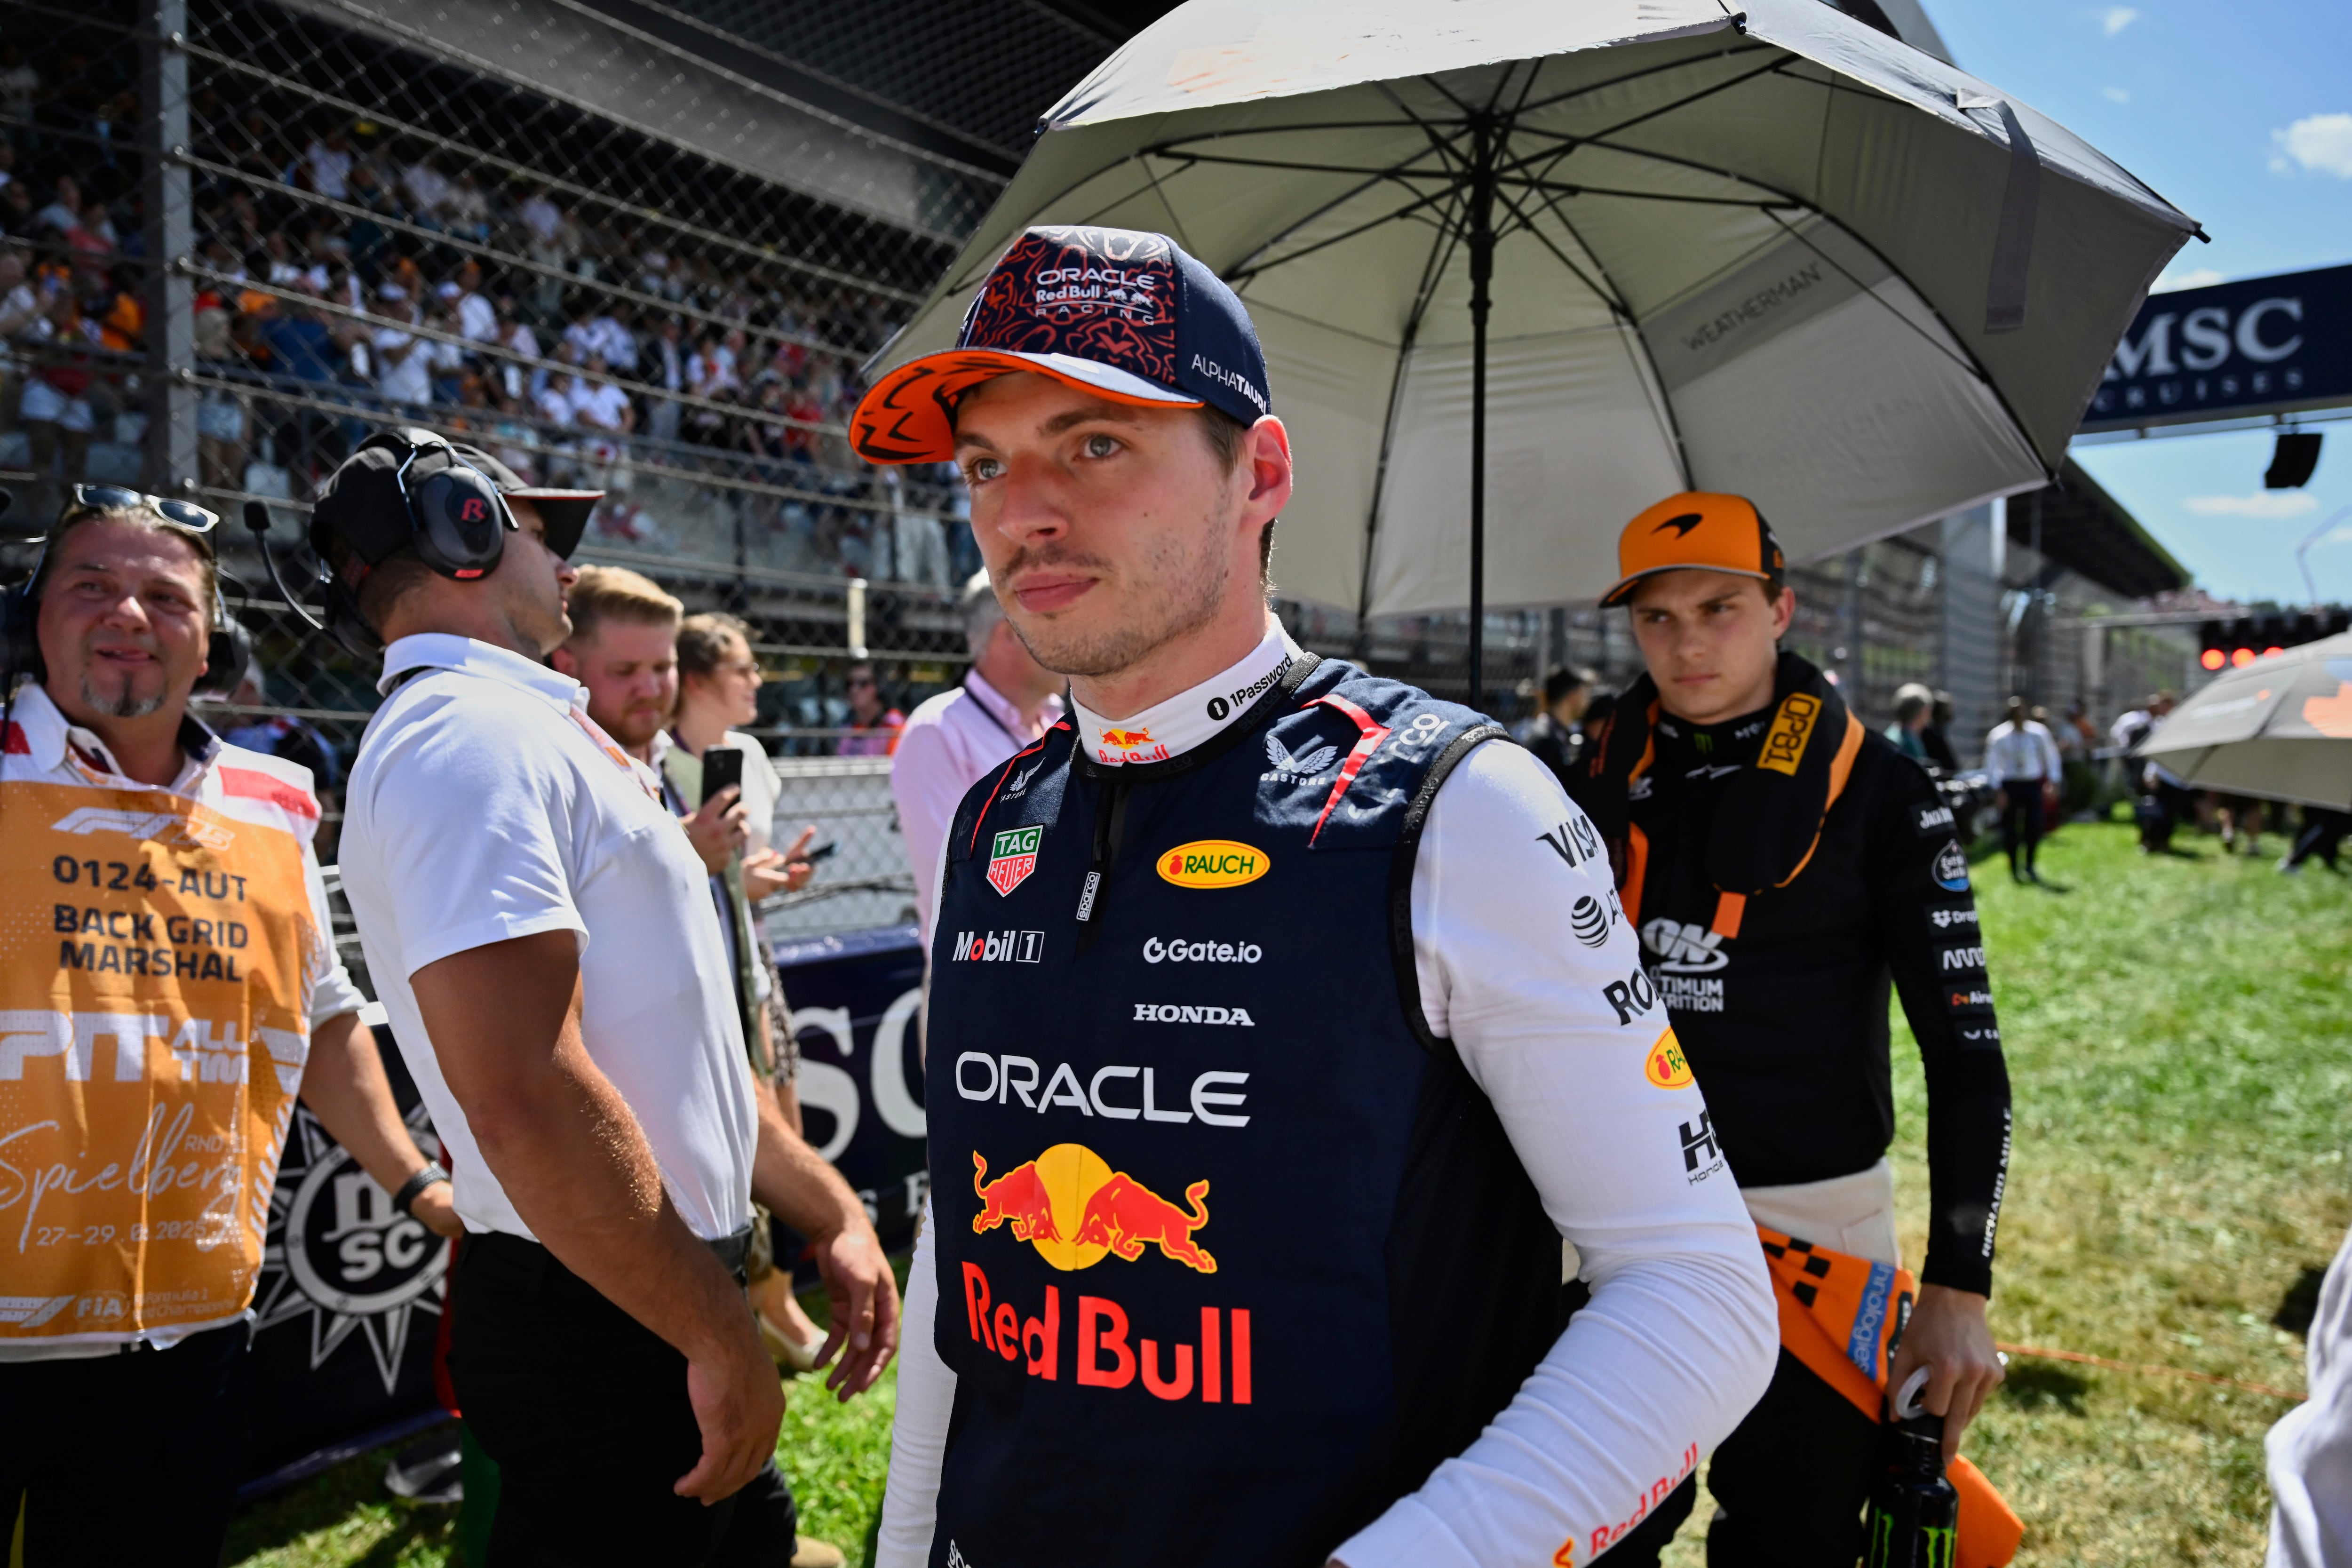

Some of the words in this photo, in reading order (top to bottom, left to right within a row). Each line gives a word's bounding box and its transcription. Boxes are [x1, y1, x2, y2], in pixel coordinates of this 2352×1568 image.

[1036, 287, 1068, 302] Red
[1069, 285, 1101, 300] Bull
[1037, 267, 1155, 289] ORACLE
[1035, 303, 1155, 326] RACING
[1680, 263, 1822, 350] WEATHERMAN
[2102, 297, 2304, 379] MSC
[1191, 353, 1267, 415] ALPHATAURI
[1230, 652, 1293, 708] 1Password
[1260, 772, 1327, 787] CASTORE
[998, 831, 1037, 855] TAG
[1535, 815, 1599, 868] VISA
[990, 857, 1033, 891] HEUER
[1184, 854, 1255, 876] RAUCH
[1078, 874, 1099, 920] sparco
[54, 904, 155, 940] BACK
[167, 915, 248, 948] GRID
[60, 940, 242, 982] MARSHAL
[952, 931, 1016, 962] Mobil
[1021, 932, 1039, 961] 1
[1168, 939, 1263, 963] Gate.io
[1133, 1003, 1255, 1027] HONDA
[955, 1051, 1251, 1128] ORACLE
[184, 1134, 224, 1153] RND
[1687, 1158, 1724, 1186] Honda
[961, 1261, 1060, 1382] Red
[1077, 1295, 1252, 1405] Bull
[1589, 1492, 1647, 1558] Red
